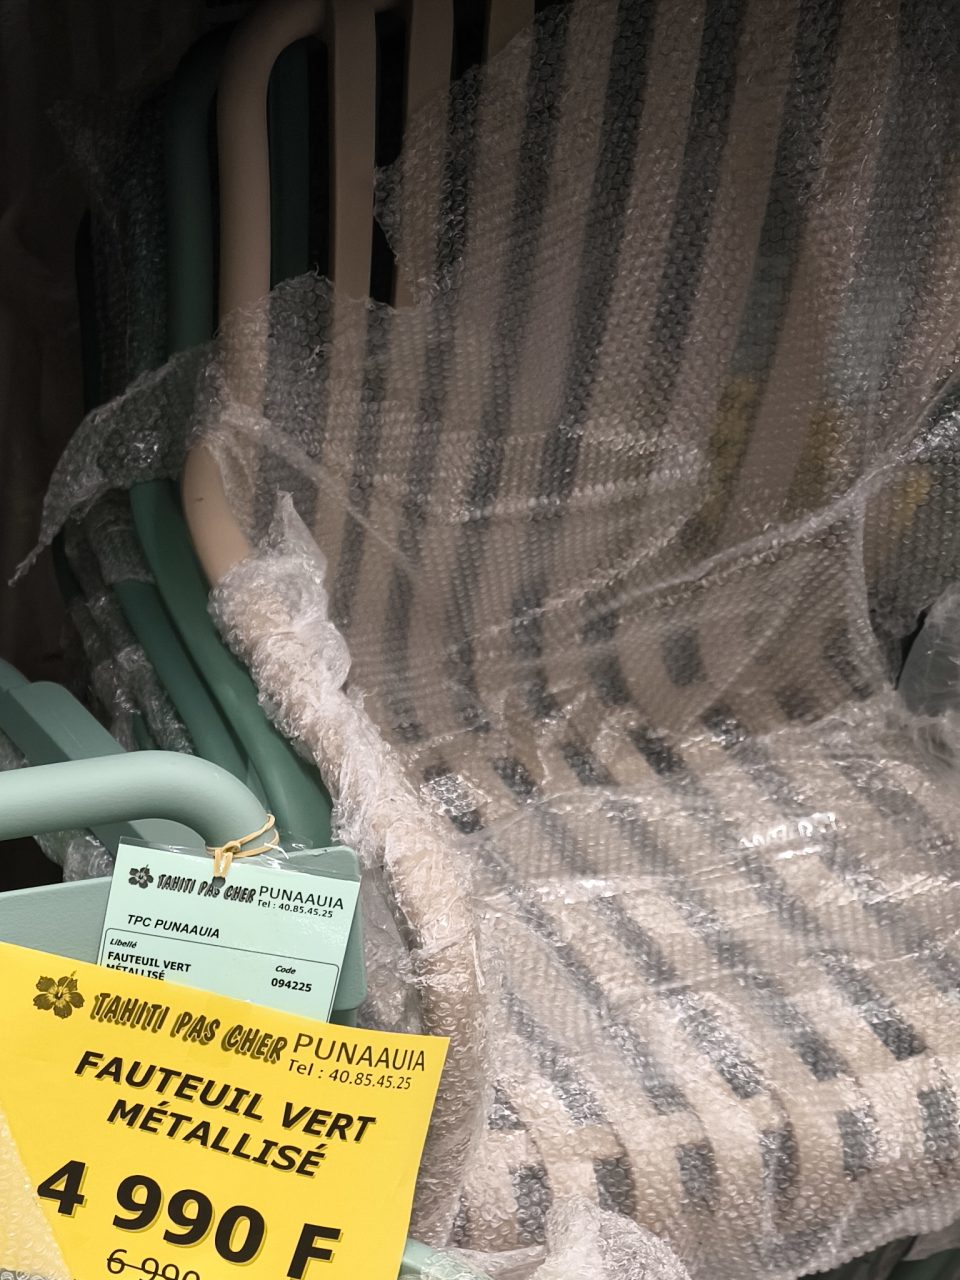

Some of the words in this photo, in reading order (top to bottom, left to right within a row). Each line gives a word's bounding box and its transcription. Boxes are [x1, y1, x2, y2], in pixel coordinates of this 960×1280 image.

[157, 873, 197, 894] TAHITI
[197, 880, 222, 898] PAS
[223, 884, 257, 904] CHER
[258, 885, 344, 910] PUNAAUIA
[257, 899, 271, 909] Tel
[278, 903, 334, 919] 40.85.45.25
[127, 914, 152, 928] TPC
[153, 919, 221, 939] PUNAAUIA
[109, 938, 138, 949] Libellé
[107, 951, 161, 968] FAUTEUIL
[163, 959, 192, 973] VERT
[275, 964, 297, 975] Code
[271, 977, 313, 993] 094225
[90, 992, 171, 1033] TAHITI
[170, 1011, 221, 1046] PAS
[221, 1024, 288, 1065] CHER
[292, 1032, 426, 1072] PUNAAUIA
[287, 1059, 314, 1077] Tel
[328, 1068, 413, 1091] 40.85.45.25
[74, 1050, 264, 1121] FAUTEUIL
[280, 1101, 377, 1143] VERT
[107, 1098, 328, 1178] MÉTALLISÉ
[37, 1160, 88, 1218] 4
[112, 1174, 267, 1265] 990
[106, 1248, 128, 1275] 6
